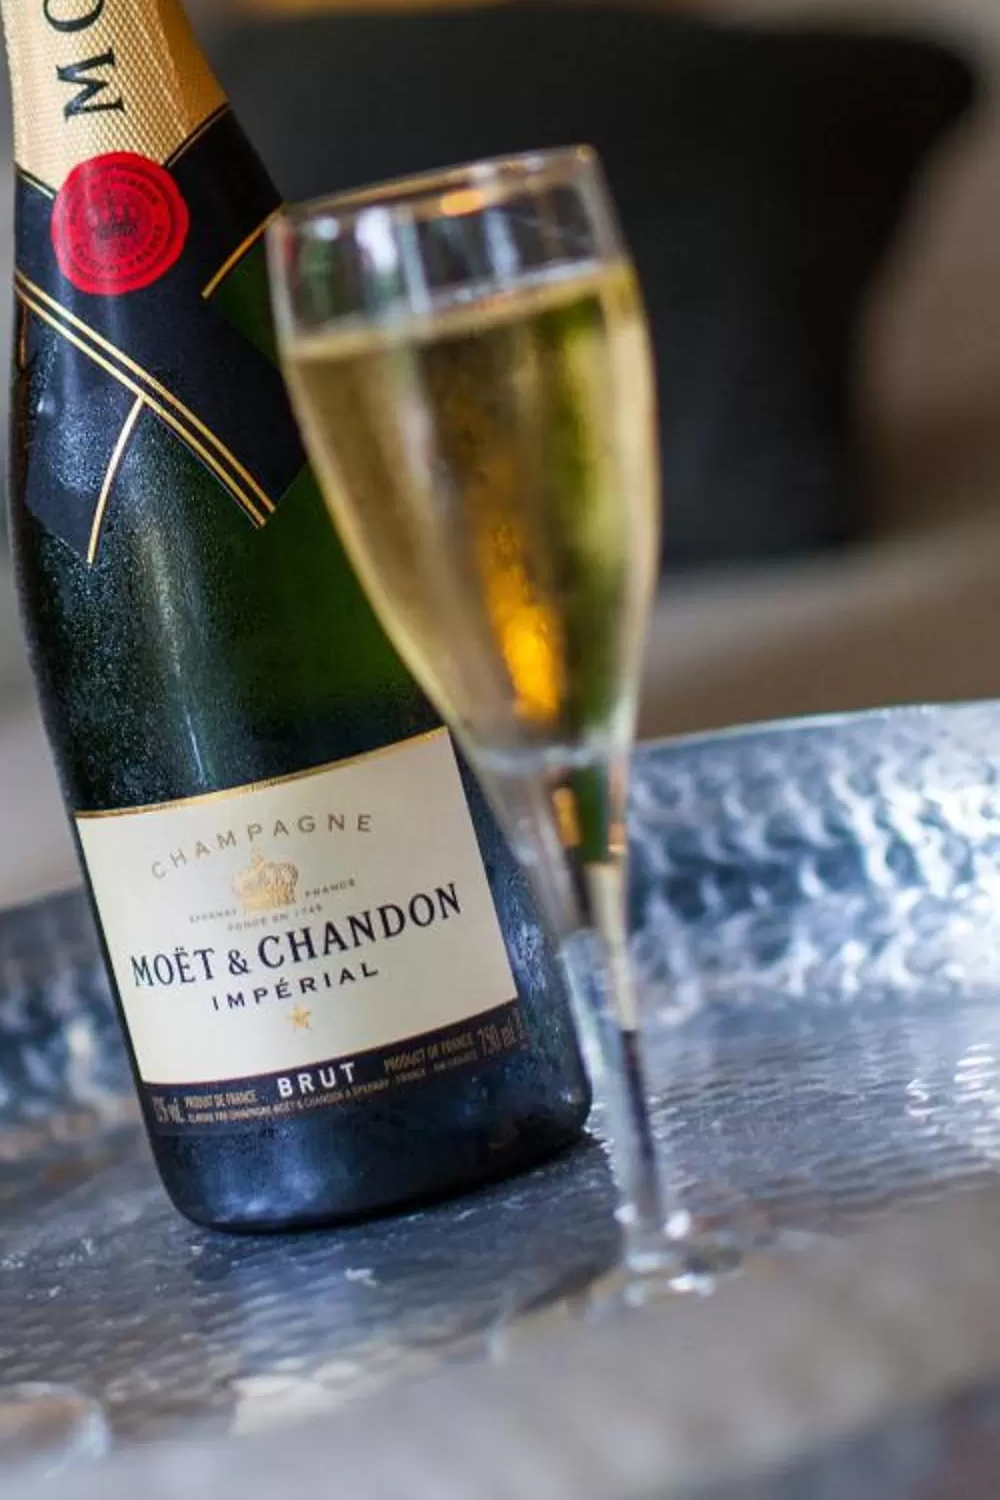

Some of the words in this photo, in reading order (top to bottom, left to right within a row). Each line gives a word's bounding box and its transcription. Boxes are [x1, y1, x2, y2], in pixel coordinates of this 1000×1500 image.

[151, 813, 372, 880] CHAMPAGNE
[130, 946, 215, 988] MOËT
[227, 949, 252, 976] &
[257, 881, 461, 970] CHANDON
[211, 961, 380, 1012] IMPÉRIAL
[276, 1061, 355, 1099] BRUT
